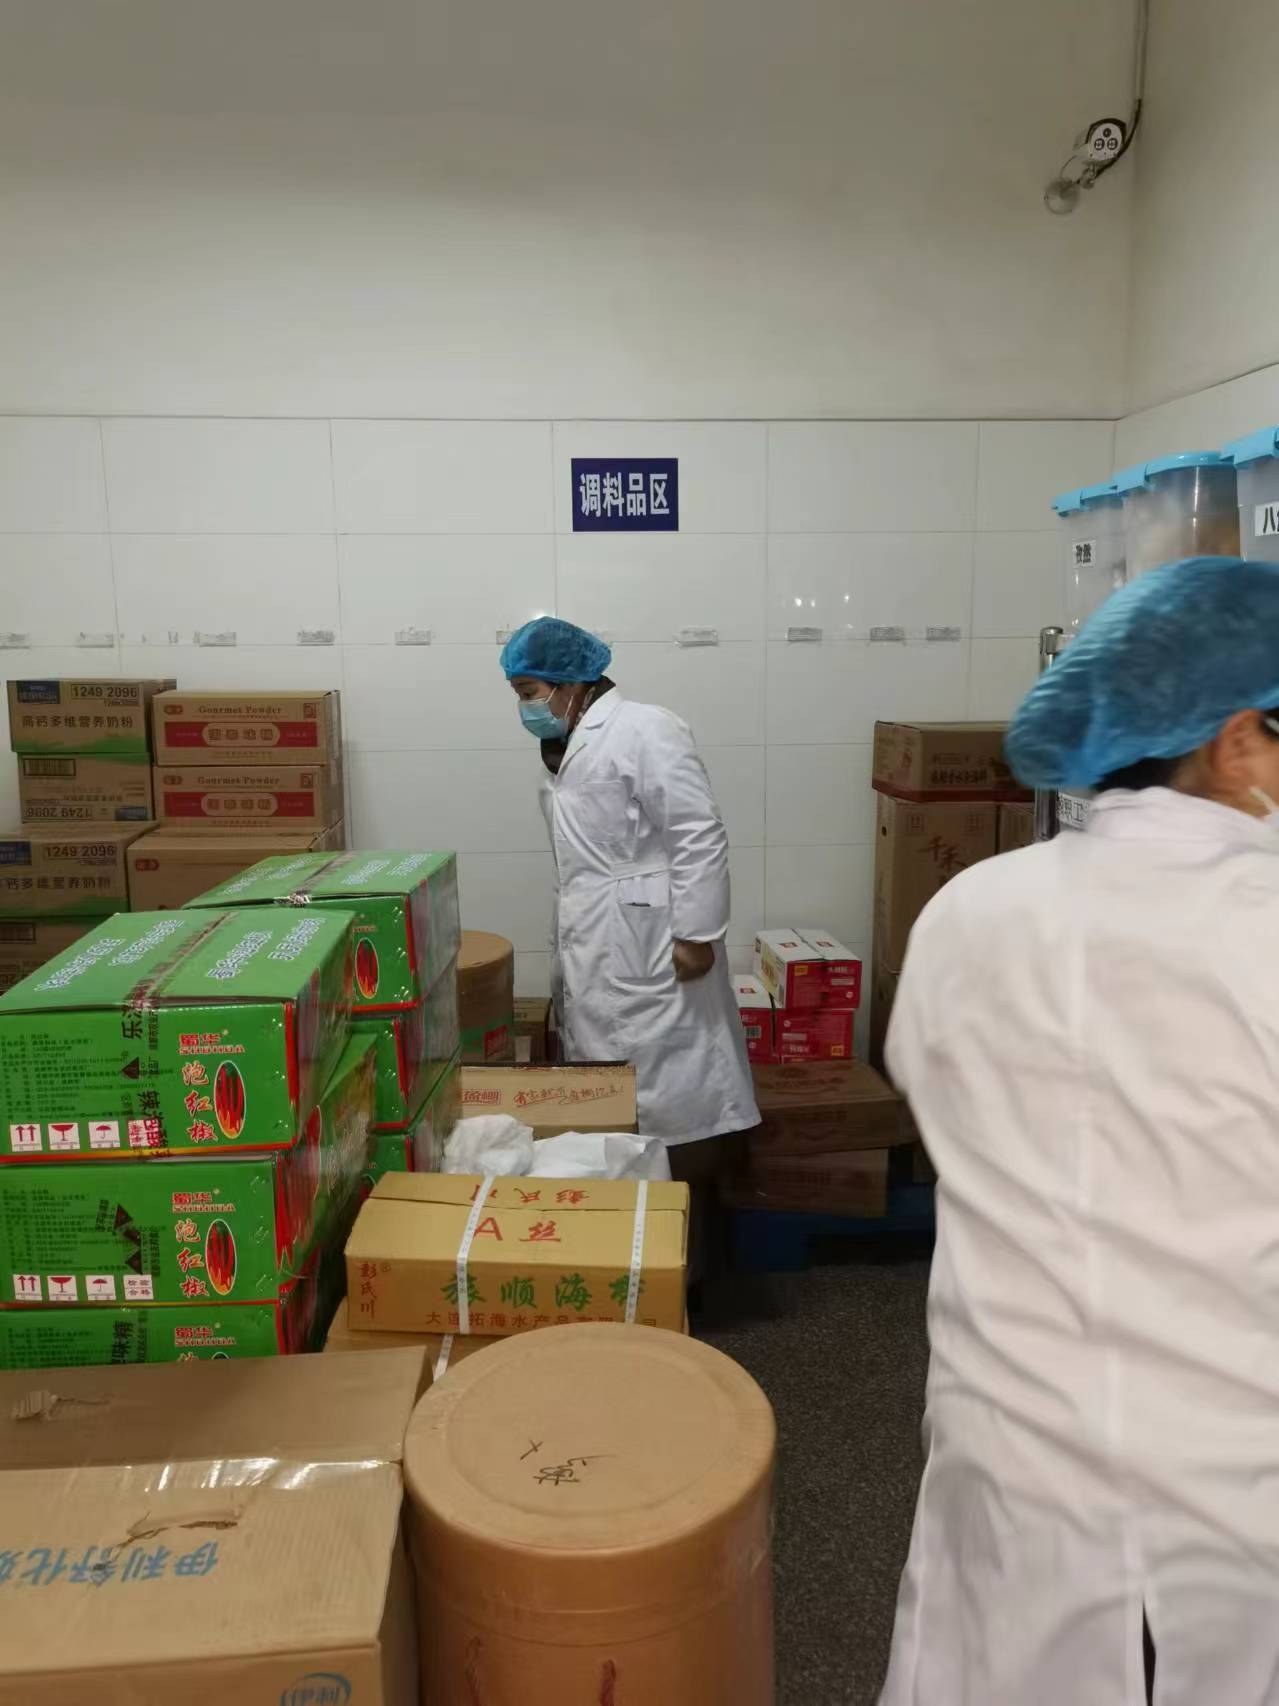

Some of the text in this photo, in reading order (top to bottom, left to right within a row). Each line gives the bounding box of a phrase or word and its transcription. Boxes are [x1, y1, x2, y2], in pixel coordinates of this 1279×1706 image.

[579, 472, 669, 517] 调料品区
[1263, 505, 1279, 533] 八
[73, 687, 103, 698] 1249
[107, 687, 138, 698] 2096
[181, 1060, 218, 1144] 泡红椒
[174, 1218, 210, 1298] 泡红椒
